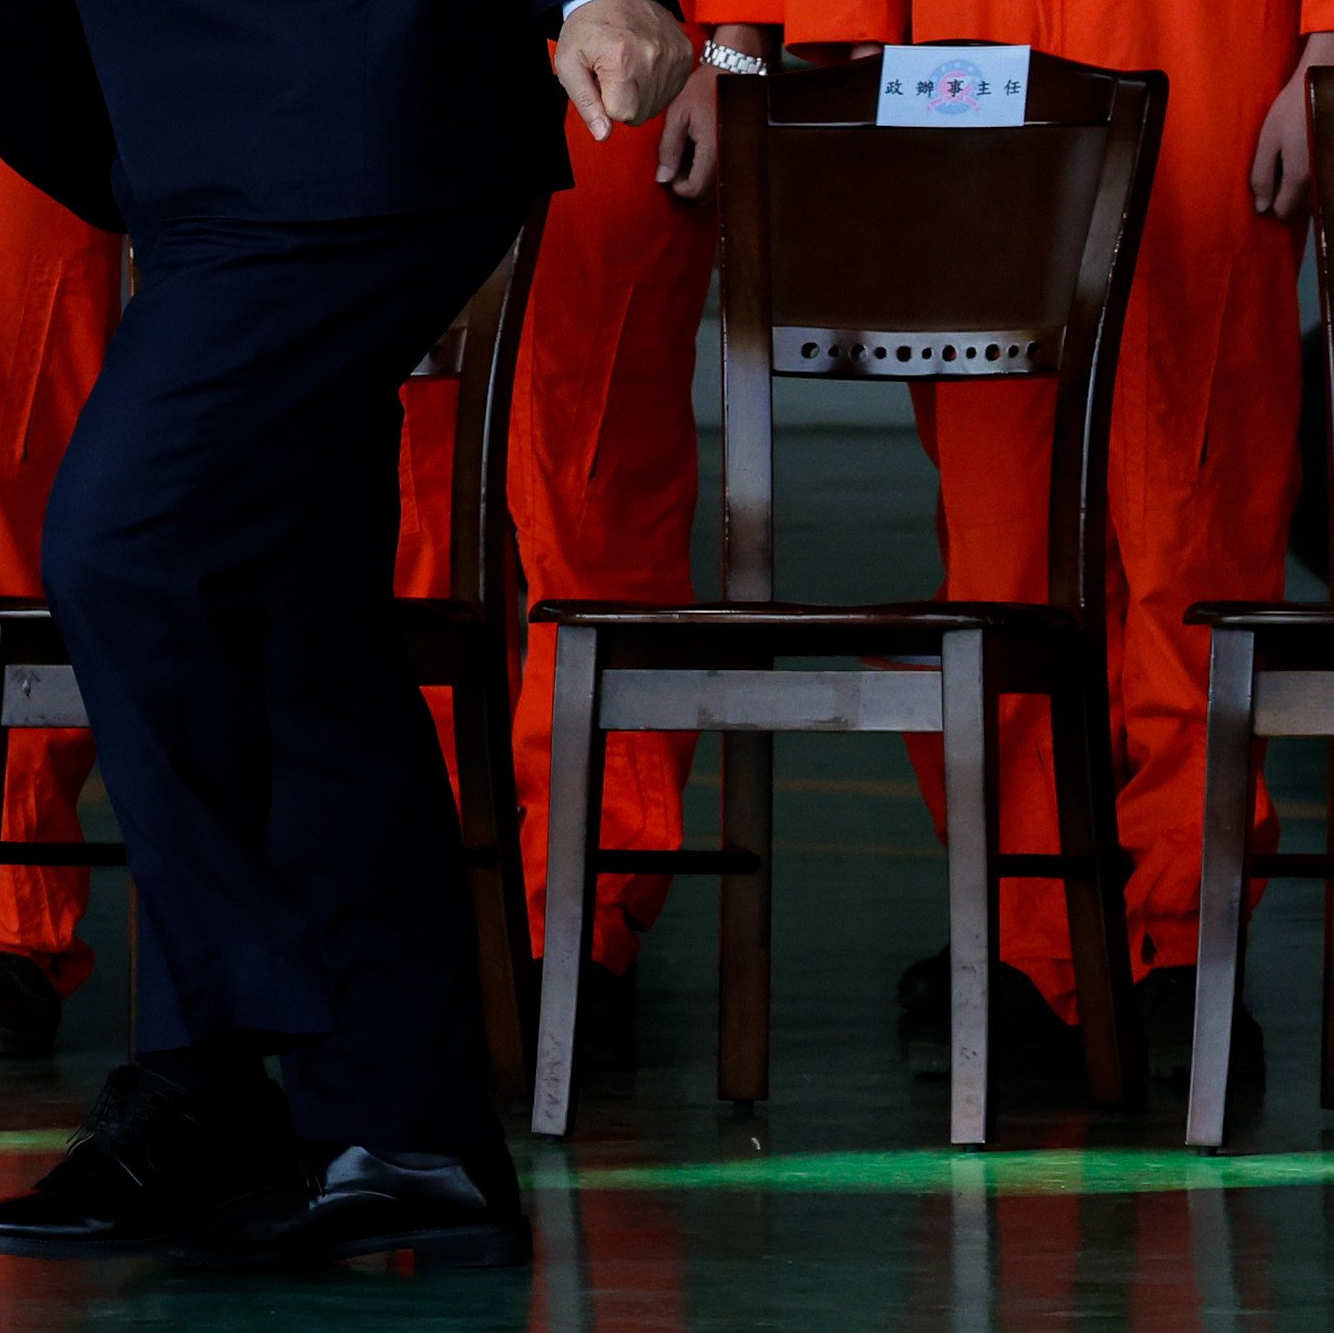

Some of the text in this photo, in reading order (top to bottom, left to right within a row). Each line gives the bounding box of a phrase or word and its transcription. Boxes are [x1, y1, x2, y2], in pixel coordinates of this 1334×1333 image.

[884, 78, 1022, 98] 政辦事主任
